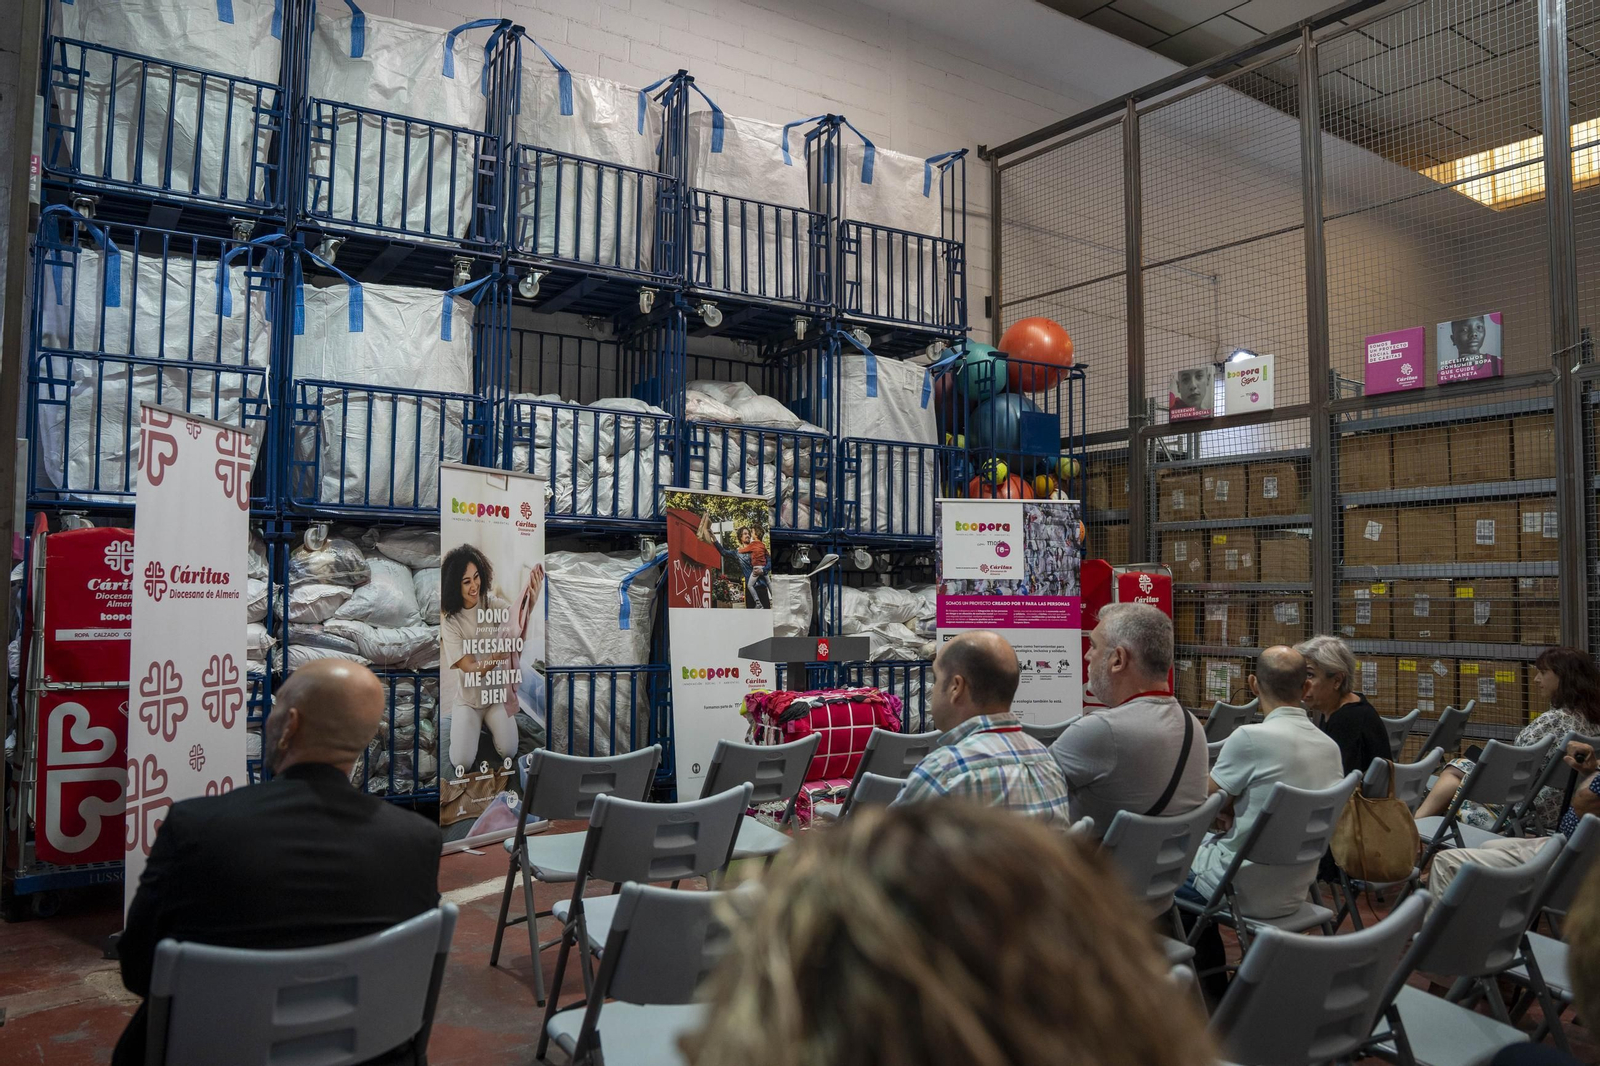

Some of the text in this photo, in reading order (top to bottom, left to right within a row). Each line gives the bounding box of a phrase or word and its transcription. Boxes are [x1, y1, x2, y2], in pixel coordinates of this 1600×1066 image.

[1379, 344, 1407, 352] PROYECTO
[1440, 354, 1484, 366] NECESITAMOS
[1440, 362, 1473, 370] CONSUMIR
[452, 497, 510, 519] koopera
[516, 520, 537, 528] Cáritas
[955, 521, 1010, 532] koopera
[170, 565, 230, 584] Cáritas
[170, 588, 240, 599] Diocesana de Almería
[477, 608, 510, 624] DONO
[476, 626, 500, 635] porque
[462, 638, 524, 654] NECESARIO
[477, 658, 508, 669] y porque
[464, 668, 523, 688] ME SIENTA
[682, 666, 740, 680] koopera
[481, 688, 508, 705] BIEN
